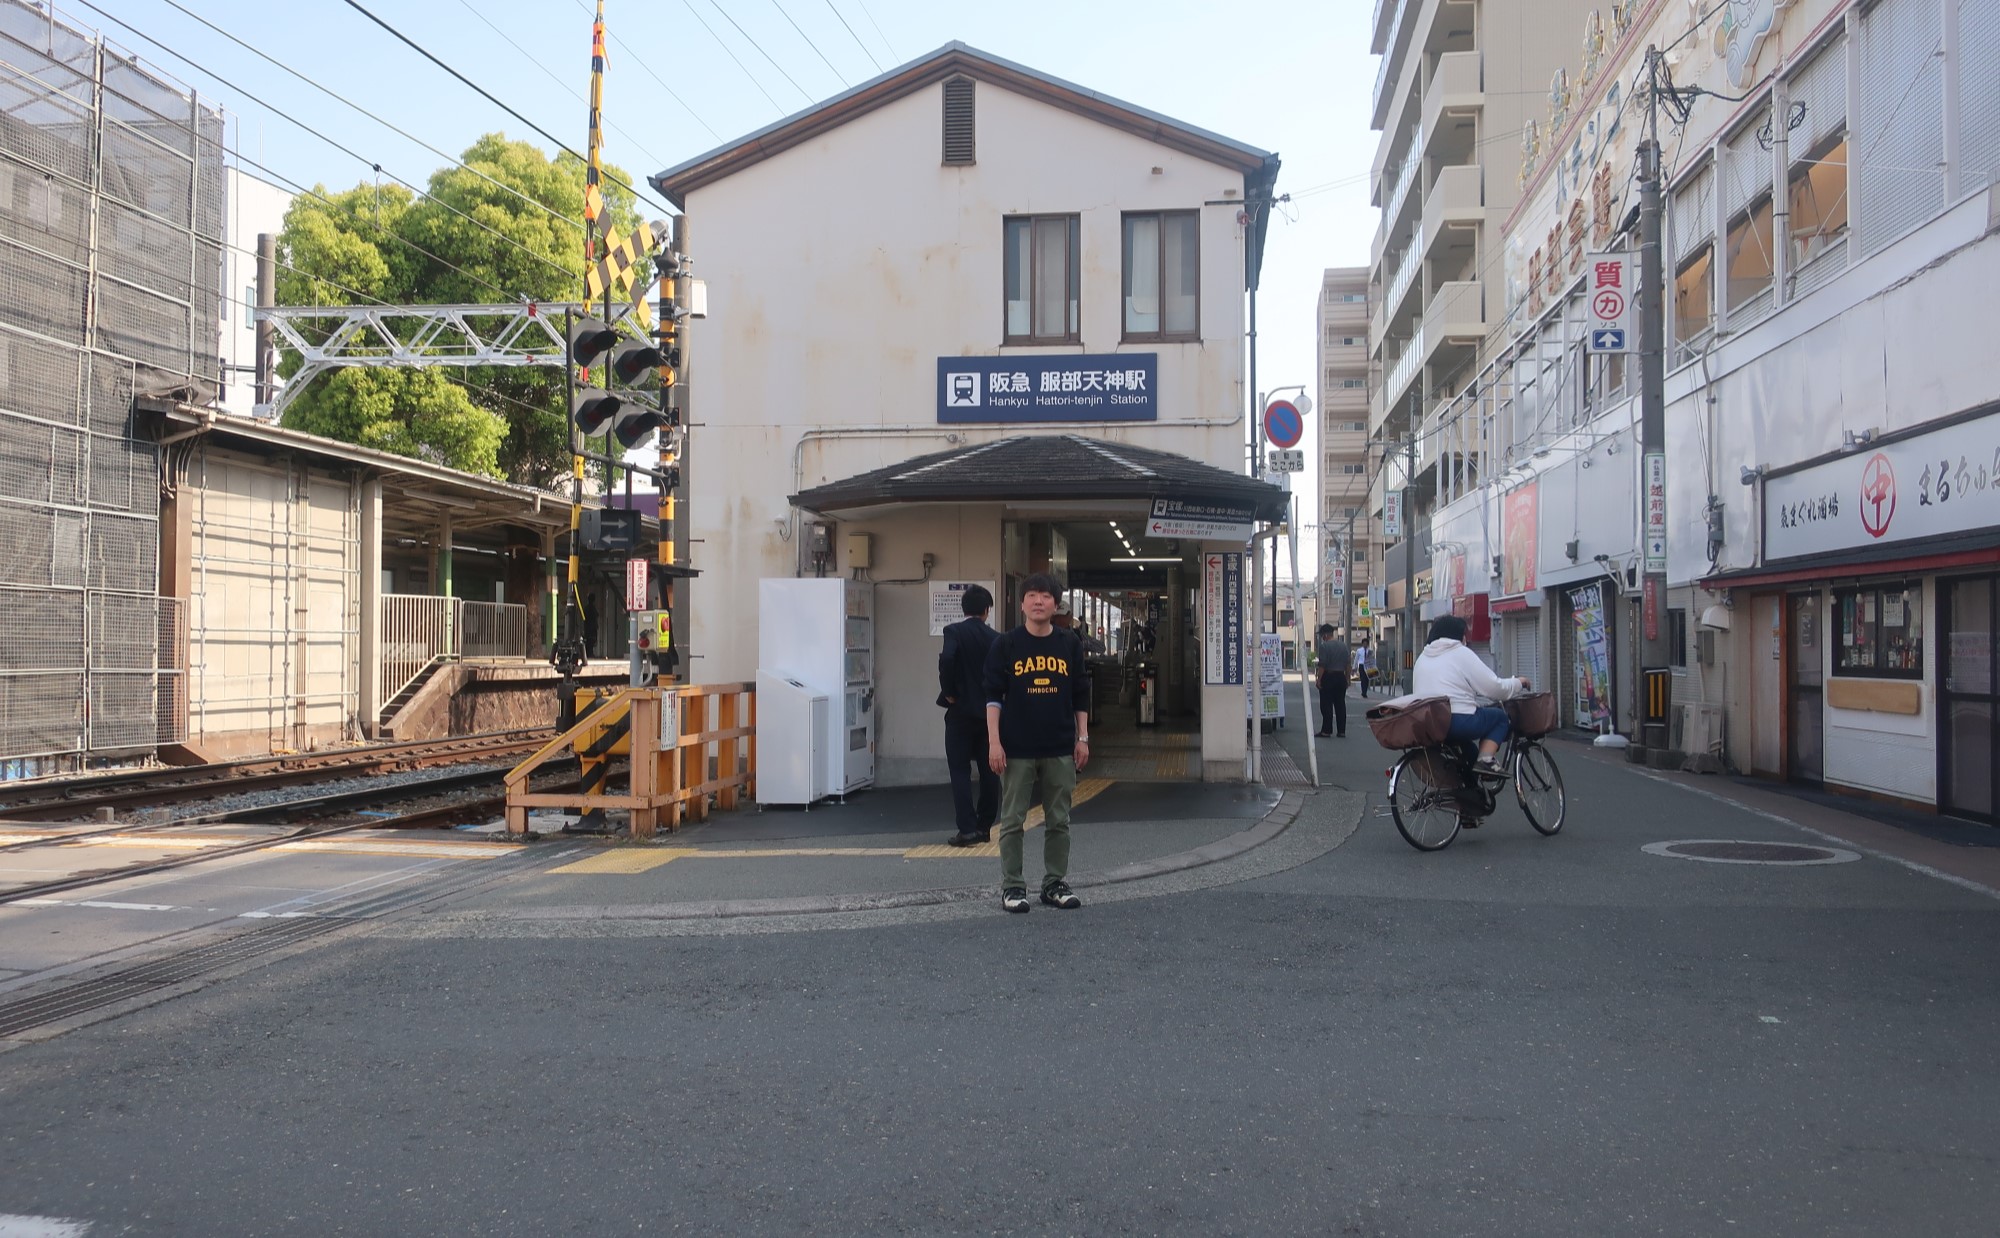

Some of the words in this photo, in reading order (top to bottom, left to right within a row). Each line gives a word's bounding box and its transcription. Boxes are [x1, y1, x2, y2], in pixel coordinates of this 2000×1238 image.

[1595, 261, 1622, 289] 質
[989, 372, 1031, 393] 阪急
[1040, 370, 1146, 392] 服部天神駅
[989, 396, 1029, 408] Hankyu
[1036, 396, 1103, 408] Hattori-tenjin
[1110, 394, 1148, 405] Station
[1271, 460, 1303, 471] ここから
[1649, 484, 1664, 526] 越前屋
[1864, 459, 1893, 532] 中
[1780, 491, 1839, 529] 気まぐれ酒場
[1014, 656, 1069, 676] SABOR
